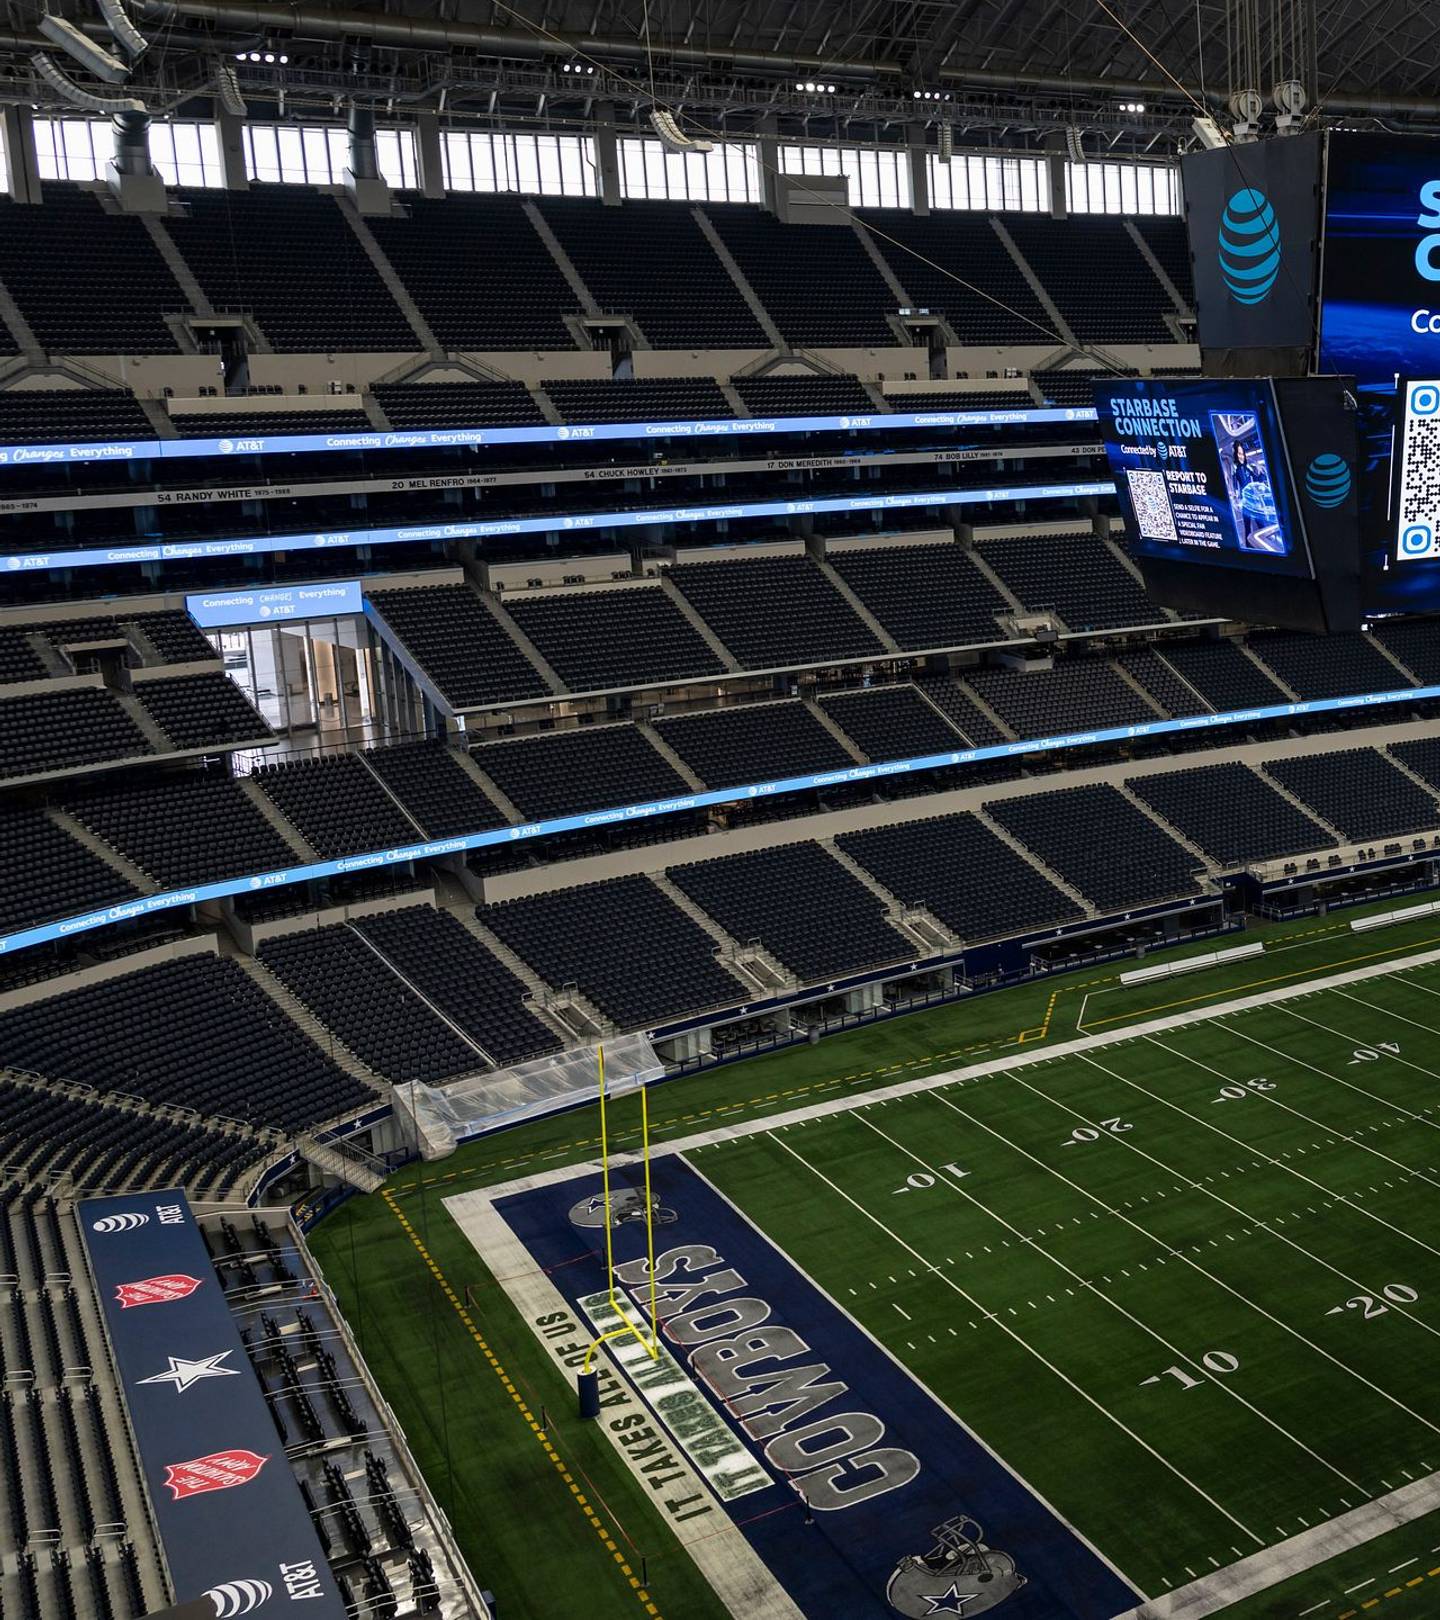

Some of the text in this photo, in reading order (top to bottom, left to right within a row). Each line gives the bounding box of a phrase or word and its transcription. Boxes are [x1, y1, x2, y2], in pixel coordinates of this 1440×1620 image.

[1076, 410, 1095, 418] AT&T
[1110, 398, 1179, 417] STARBASE
[851, 418, 871, 426] AT&T
[915, 415, 954, 425] Connecting
[990, 412, 1027, 422] Everything
[571, 428, 595, 438] AT&T
[646, 424, 691, 434] Connecting
[732, 421, 775, 432] Everything
[1115, 417, 1202, 438] CONNECTION
[236, 440, 265, 451] AT&T
[327, 437, 381, 448] Connecting
[431, 432, 481, 444] Everything
[13, 448, 64, 461] Changes
[70, 446, 133, 459] Everything
[1168, 445, 1186, 458] AT&T
[598, 469, 625, 478] CHUCK
[627, 467, 659, 476] HOWLEY
[778, 461, 794, 469] DON
[392, 481, 404, 489] 20
[409, 480, 427, 488] MEL
[429, 478, 465, 487] RENFRO
[1166, 470, 1207, 483] REPORT TO
[157, 494, 171, 502] 54
[176, 490, 214, 501] RANDY
[218, 489, 252, 499] WHITE
[1169, 483, 1207, 496] STARBASE
[398, 529, 441, 539] Connecting
[480, 523, 521, 533] Everything
[575, 519, 594, 527] AT&T
[327, 536, 350, 544] AT&T
[108, 549, 159, 561] Connecting
[206, 542, 254, 554] Everything
[24, 557, 49, 567] AT&T
[203, 588, 346, 608] Connecting Everything
[273, 605, 295, 614] AT&T
[584, 810, 624, 824] Connecting
[658, 798, 695, 812] Everything
[521, 826, 541, 836] AT&T
[337, 856, 384, 870] Connecting
[424, 838, 467, 853] Everything
[264, 873, 287, 885] AT&T
[59, 915, 106, 933] Connecting
[147, 891, 196, 909] Everything
[1354, 1042, 1401, 1062] 40
[1220, 1077, 1277, 1101] 30
[1070, 1117, 1133, 1142] 20
[907, 1161, 972, 1190] 10
[157, 1204, 185, 1226] AT&T
[1344, 1282, 1420, 1320] 20
[536, 1311, 577, 1339] US
[612, 1245, 921, 1511] COWBOYS
[1159, 1349, 1240, 1392] 10
[609, 1413, 686, 1490] TAKES
[664, 1493, 713, 1523] IT
[279, 1560, 324, 1602] AT&T
